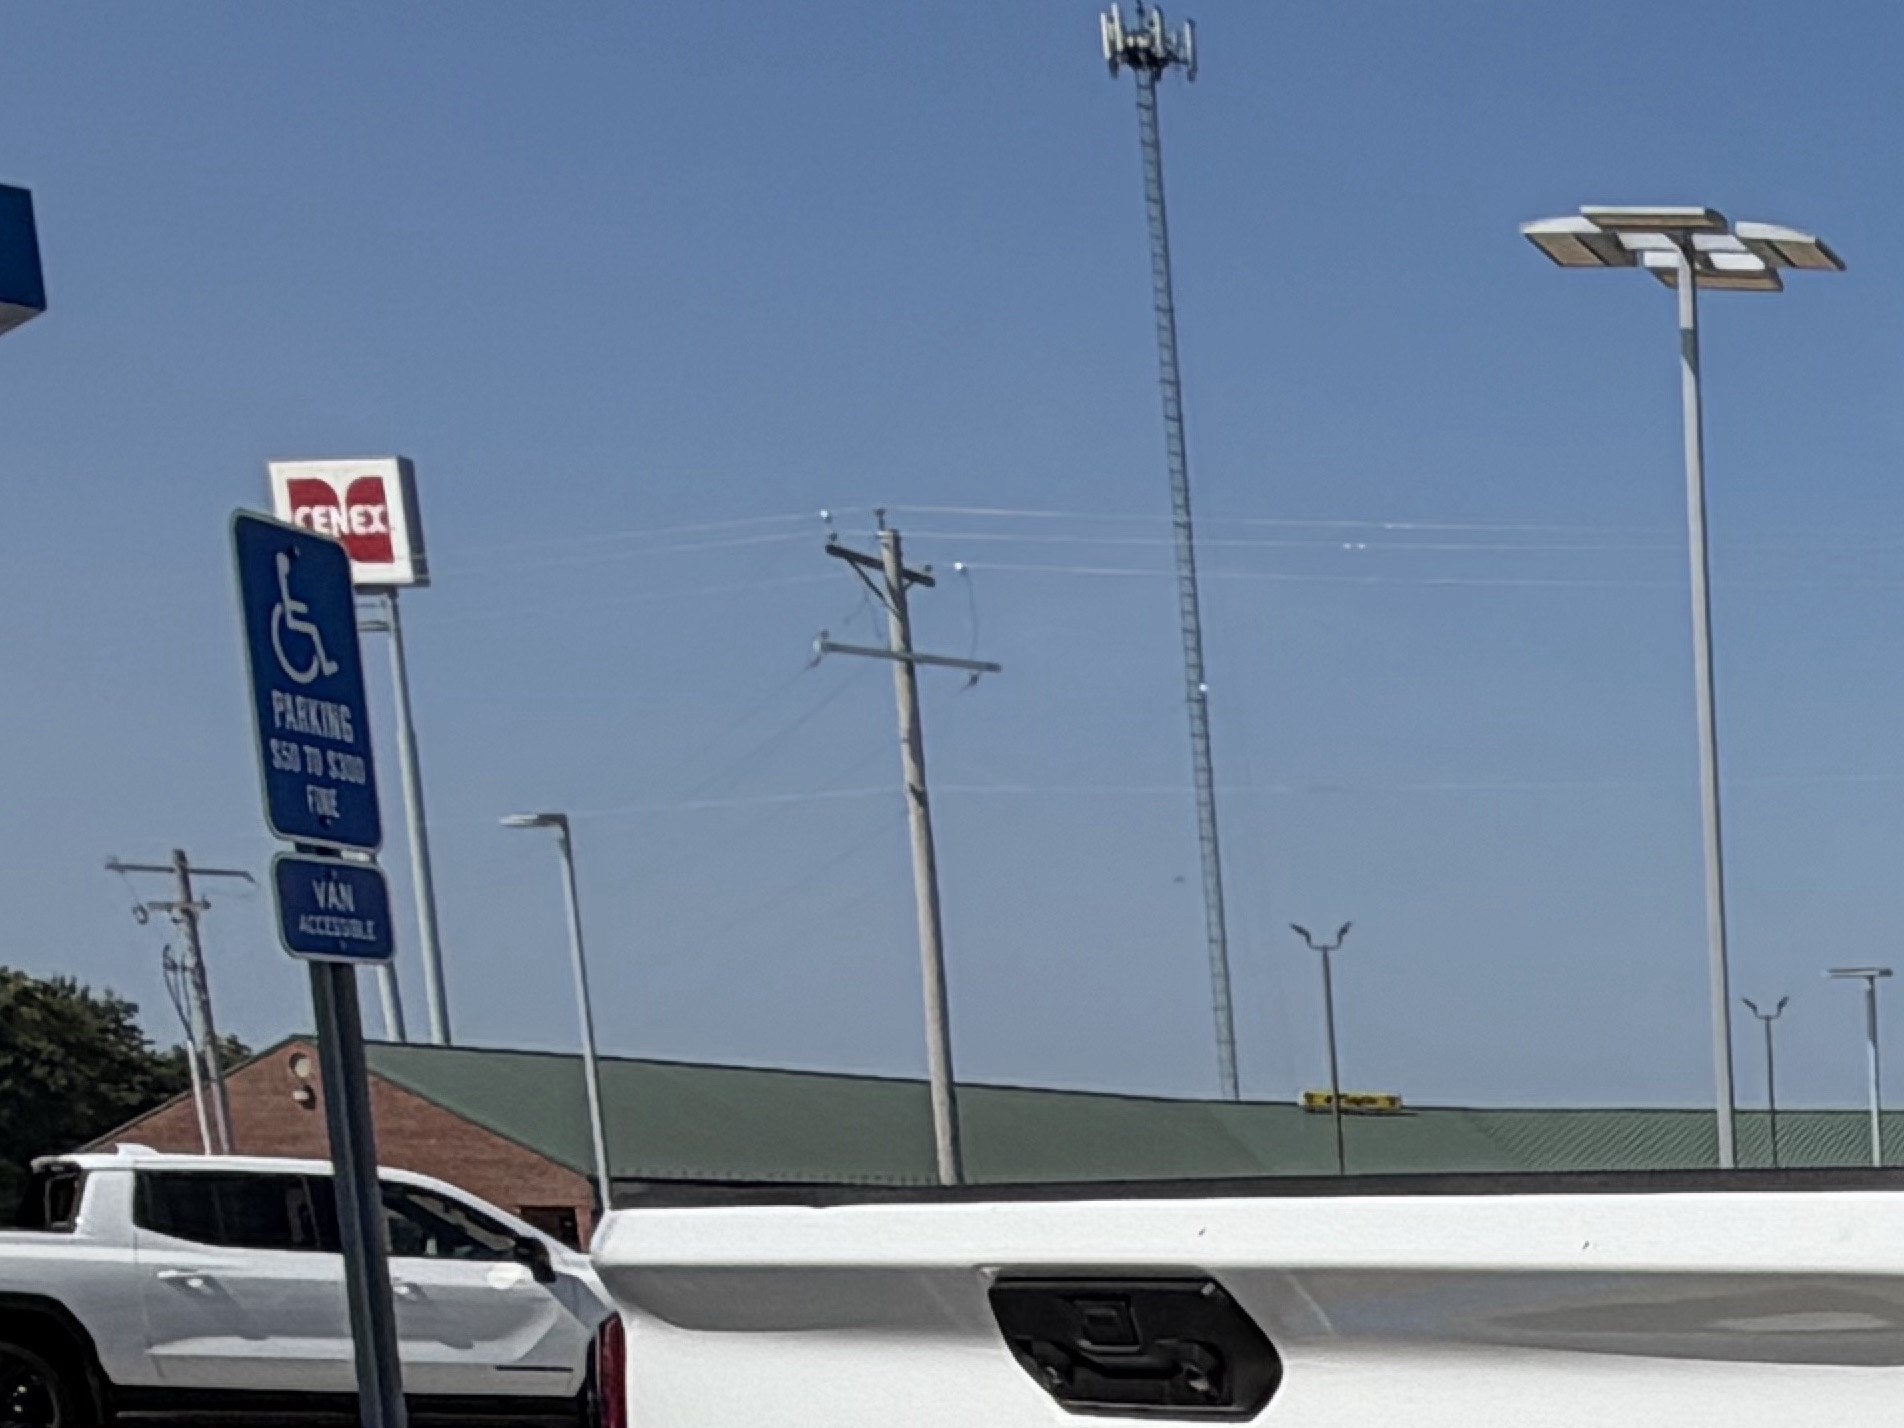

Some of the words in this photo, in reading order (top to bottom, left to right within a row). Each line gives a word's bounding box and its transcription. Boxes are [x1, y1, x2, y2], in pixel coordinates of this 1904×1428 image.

[294, 504, 388, 537] CENEX
[272, 688, 354, 744] PARKING
[303, 744, 324, 777] TO
[306, 784, 341, 818] FINE
[312, 879, 356, 912] VAN
